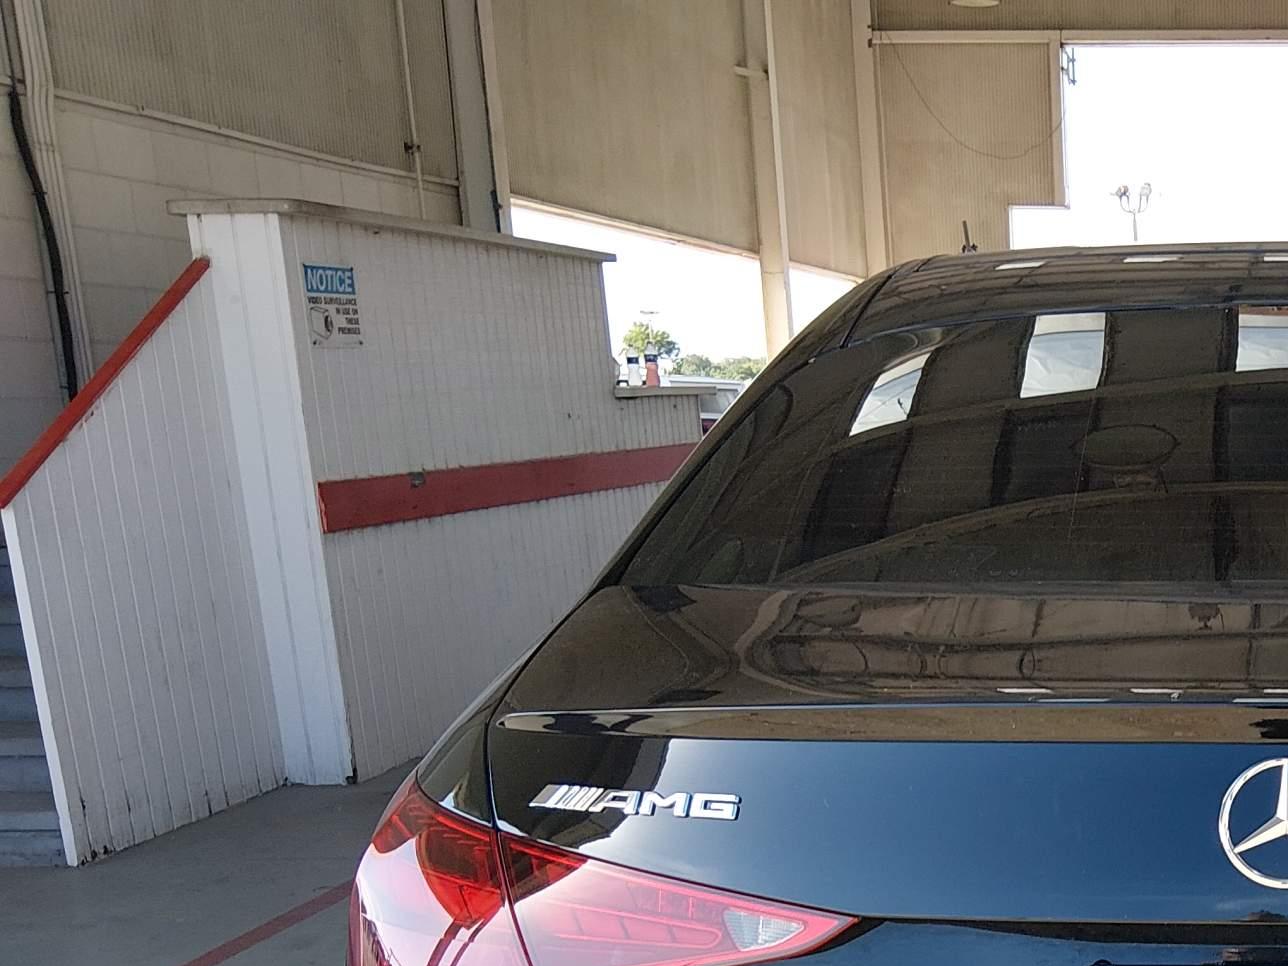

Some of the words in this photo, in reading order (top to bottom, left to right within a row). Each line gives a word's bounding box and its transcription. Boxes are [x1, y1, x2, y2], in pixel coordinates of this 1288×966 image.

[307, 268, 353, 292] NOTICE
[307, 296, 322, 305] VIDEO
[323, 296, 358, 306] SURVEILLANCE
[337, 326, 361, 335] PREMISES
[589, 788, 741, 820] AMG
